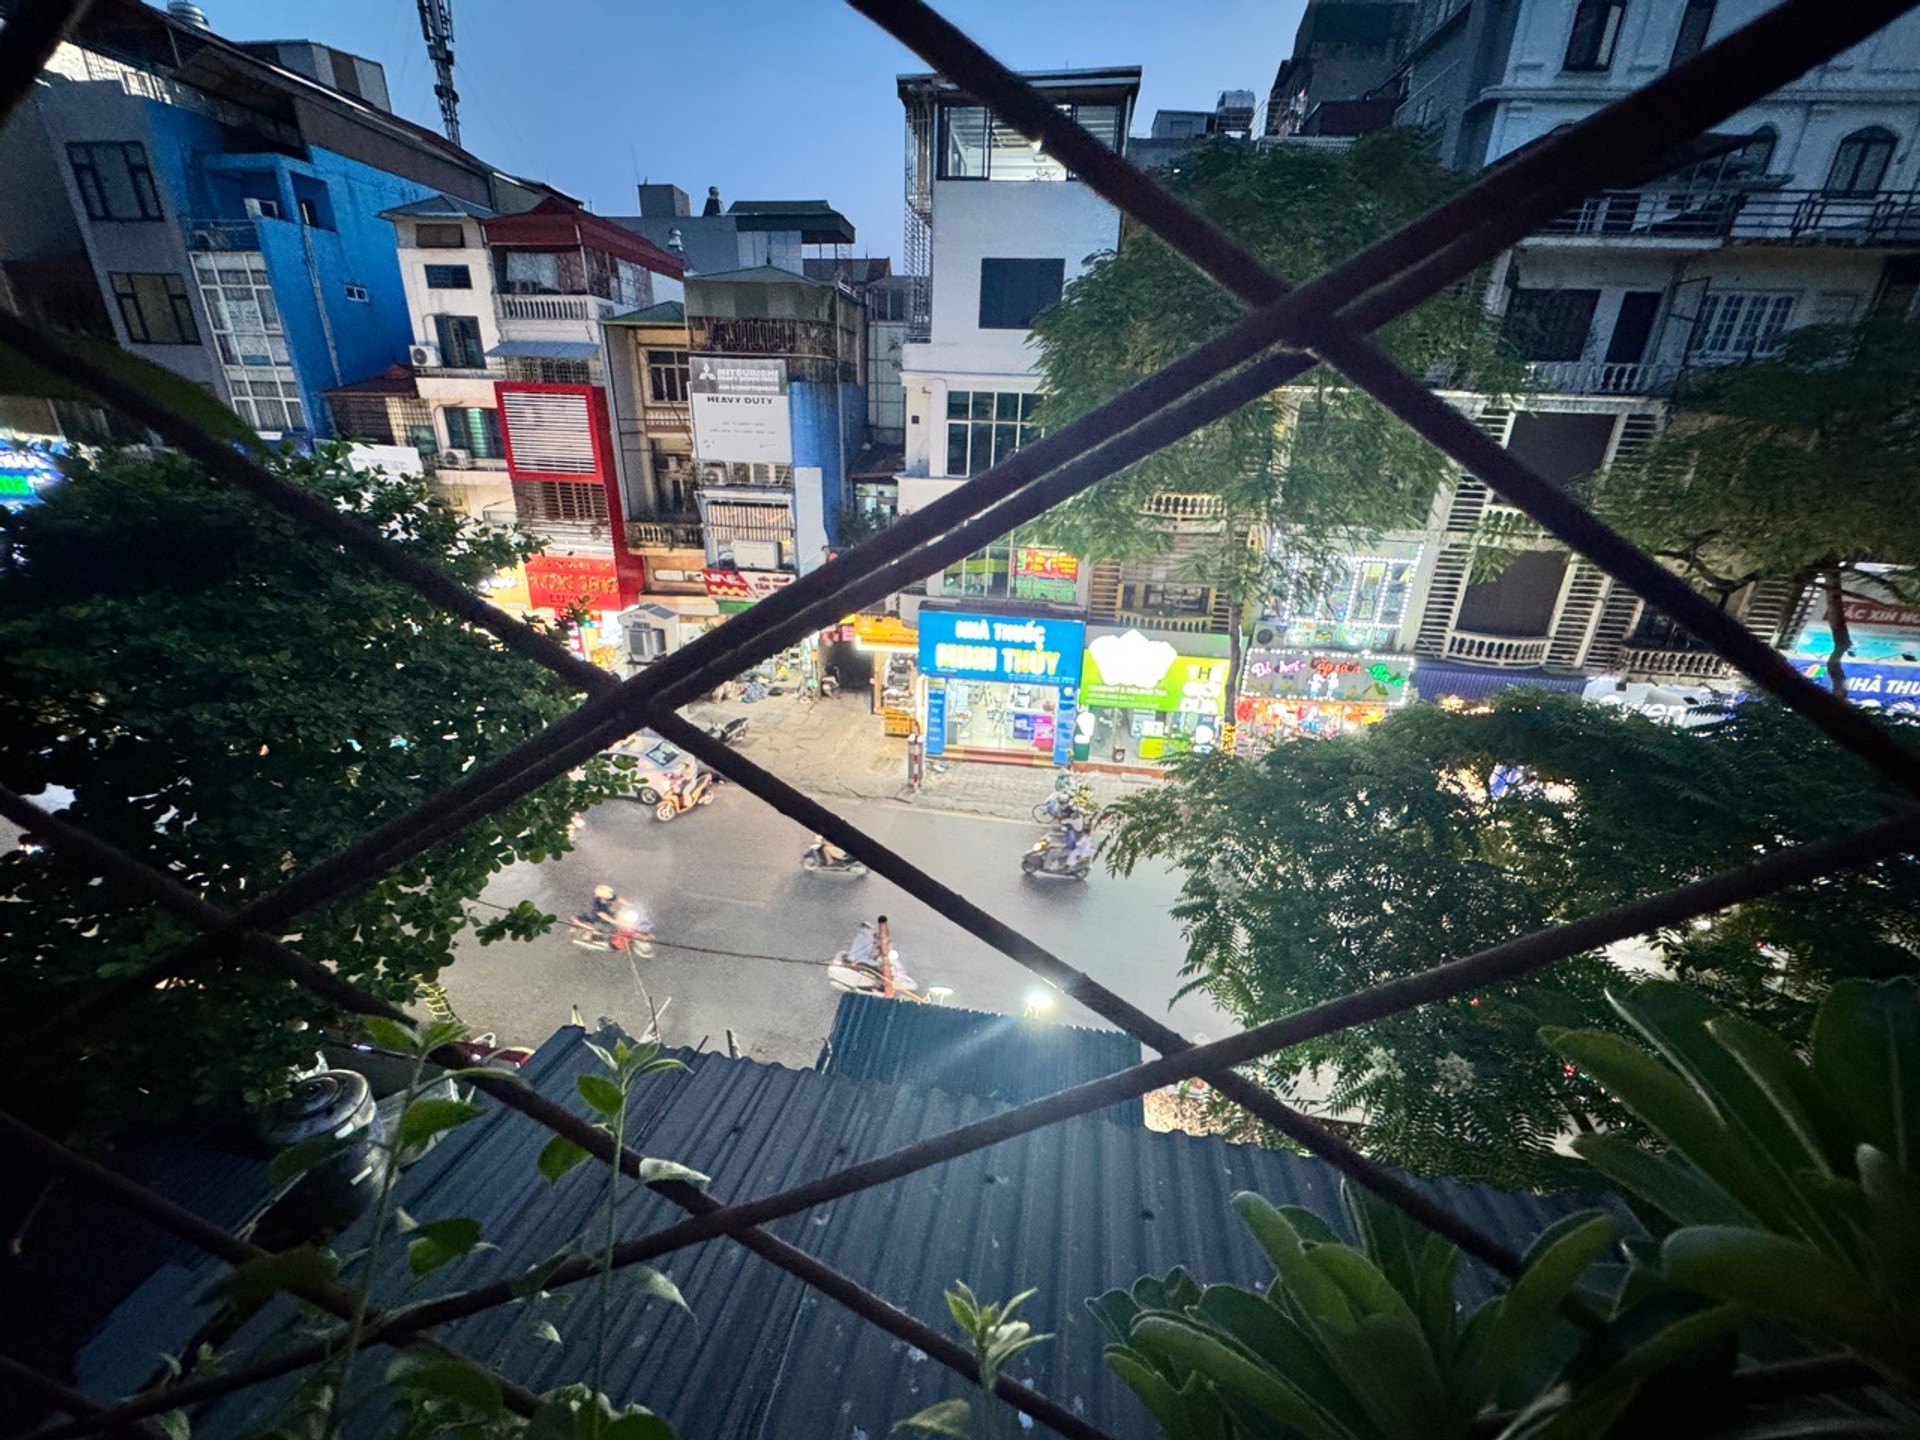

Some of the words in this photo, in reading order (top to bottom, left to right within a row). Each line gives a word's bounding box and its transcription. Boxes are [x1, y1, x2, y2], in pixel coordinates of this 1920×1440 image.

[707, 396, 741, 404] HEAVY
[744, 397, 773, 405] DUTY
[955, 619, 990, 640] NHÀ
